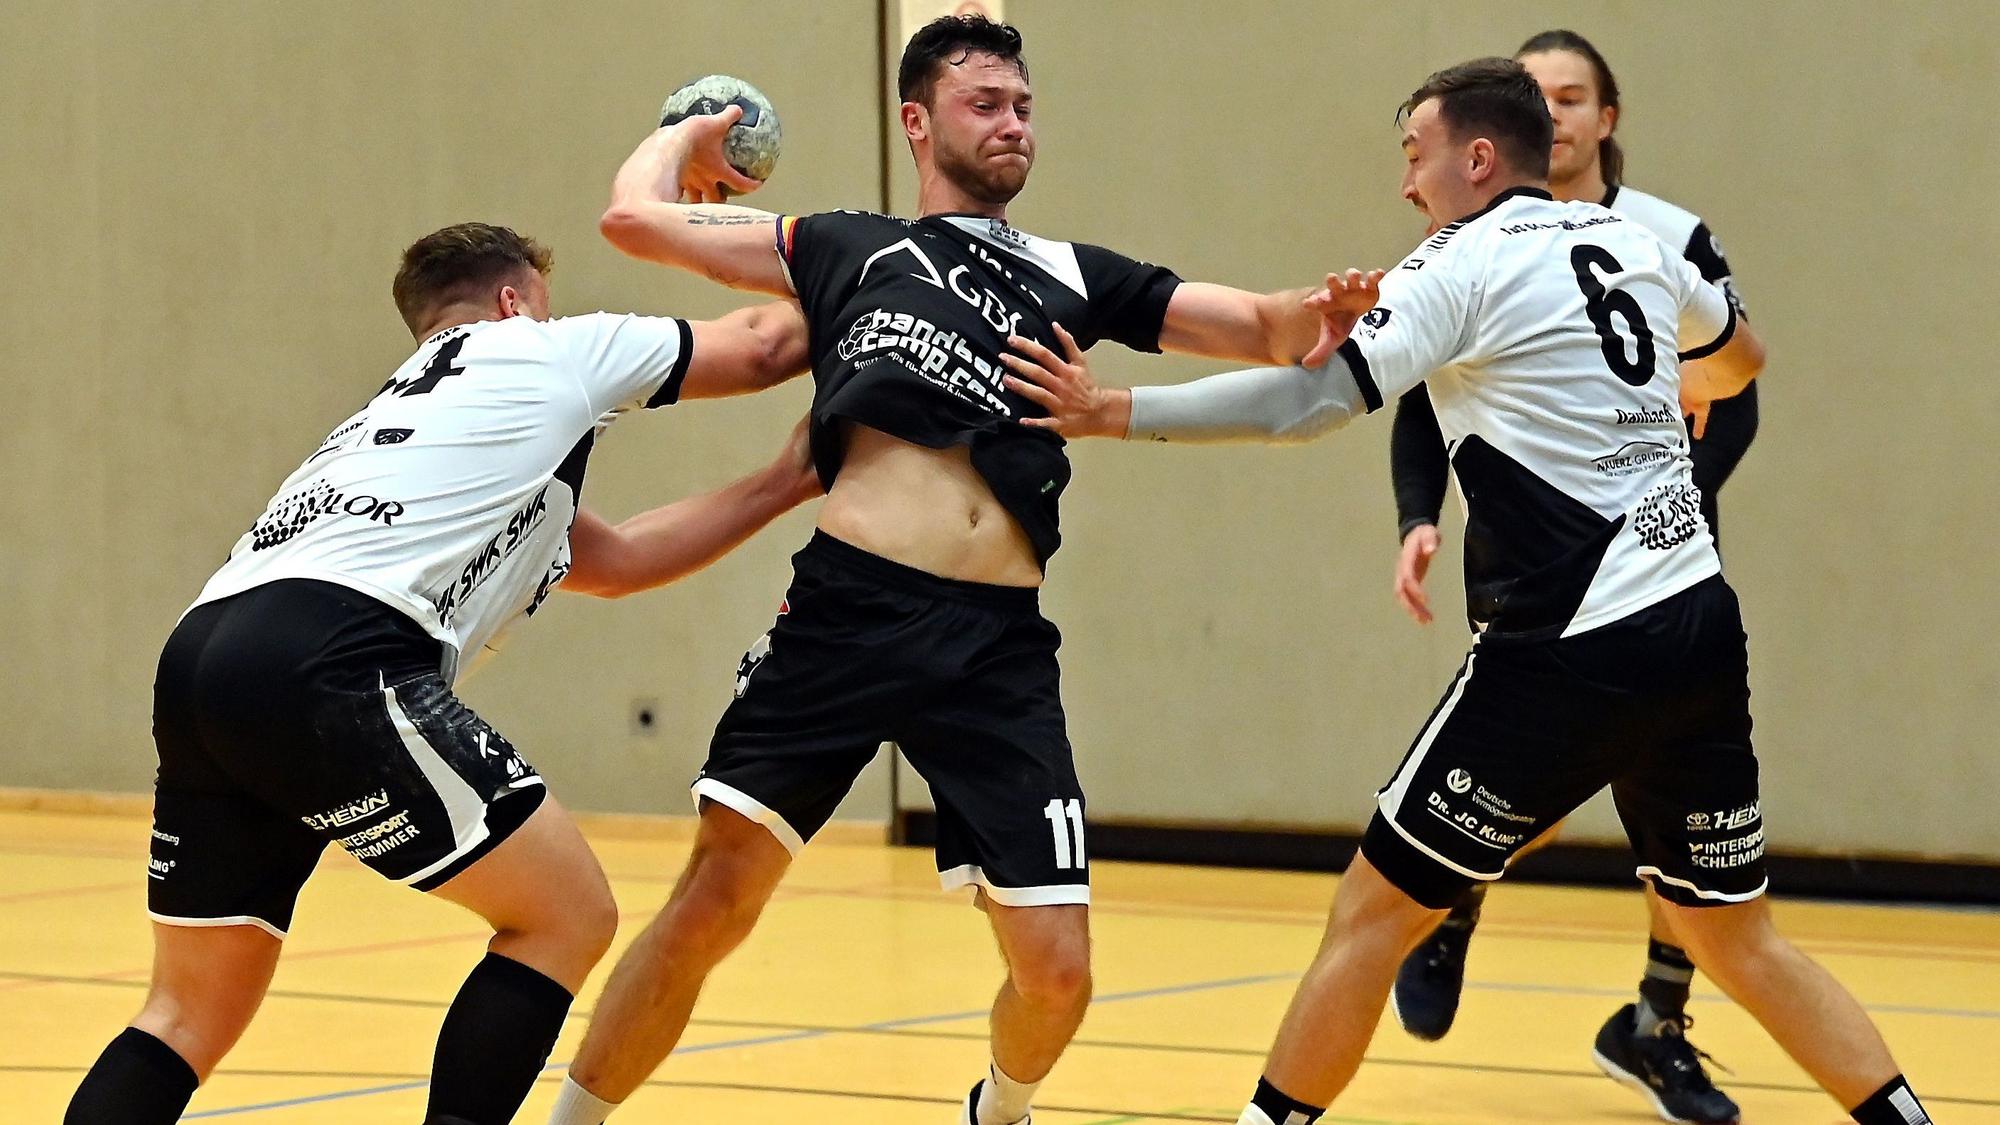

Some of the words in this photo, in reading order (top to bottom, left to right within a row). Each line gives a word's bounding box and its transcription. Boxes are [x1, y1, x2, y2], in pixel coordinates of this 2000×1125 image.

[1570, 244, 1656, 386] 6
[458, 530, 502, 602] SWK
[504, 485, 548, 553] SWK
[314, 791, 390, 828] HENN
[1427, 791, 1450, 815] DR.
[1454, 812, 1478, 829] JC
[1477, 785, 1511, 810] Deutsche
[1714, 800, 1761, 831] HEN
[1044, 798, 1086, 870] 11
[1705, 825, 1764, 855] INTERSPO
